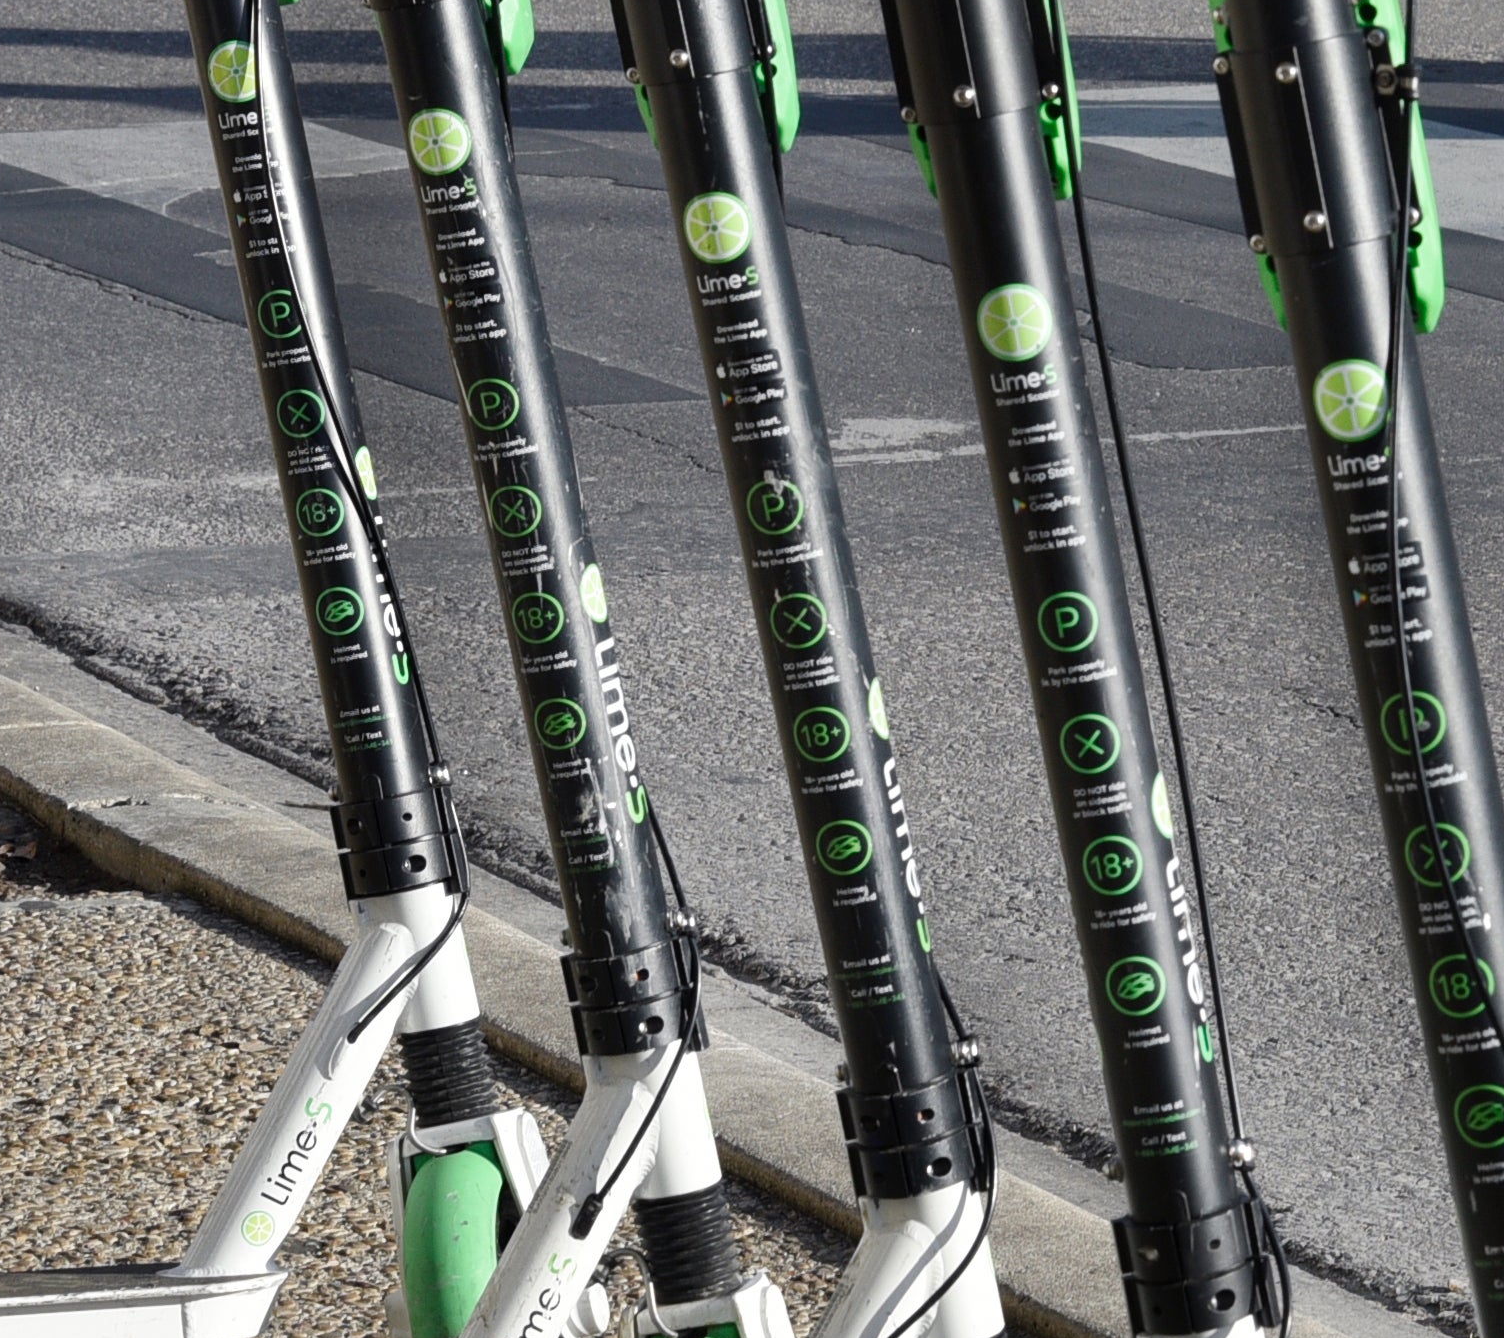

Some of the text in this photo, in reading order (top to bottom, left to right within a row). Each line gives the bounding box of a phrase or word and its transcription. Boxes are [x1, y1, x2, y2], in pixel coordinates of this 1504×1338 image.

[244, 190, 262, 203] App
[447, 236, 485, 250] Lime App
[450, 266, 495, 284] App Store
[456, 296, 483, 309] Google
[484, 292, 501, 303] Play
[729, 289, 762, 302] Scooter
[270, 301, 290, 328] P
[478, 328, 507, 340] in app
[716, 318, 759, 334] Download
[727, 332, 748, 343] Lime
[749, 328, 768, 340] App
[729, 360, 779, 379] App Store
[735, 392, 767, 405] Google
[766, 388, 785, 399] Play
[996, 388, 1060, 407] Shared Scooter
[480, 391, 501, 419] P
[745, 421, 755, 430] to
[1012, 421, 1056, 436] Download
[731, 425, 791, 443] unlock in app
[1023, 434, 1046, 445] Lime
[1047, 431, 1065, 442] App
[1024, 465, 1074, 483] App Store
[762, 493, 785, 522] P
[1029, 498, 1063, 511] Google
[1063, 495, 1081, 506] Play
[302, 503, 336, 526] 18+
[1028, 529, 1050, 540] $1 to
[1362, 522, 1387, 534] Lime
[757, 542, 812, 558] Park properly
[1023, 535, 1086, 553] unlock in app
[1364, 561, 1388, 574] App
[518, 607, 555, 631] 18+
[1055, 606, 1079, 638] P
[783, 656, 834, 671] DO NOT ride
[1048, 660, 1105, 676] Park properly
[797, 665, 835, 680] sidewalk
[791, 674, 841, 691] block traffic
[1051, 677, 1061, 688] by
[1062, 676, 1077, 686] the
[800, 722, 842, 748] 18+
[840, 768, 855, 780] old
[825, 783, 837, 792] for
[839, 776, 864, 791] safety
[1073, 788, 1086, 797] DO
[1088, 784, 1107, 795] NOT
[1088, 791, 1127, 806] sidewalk
[1082, 801, 1133, 819] block traffic
[1091, 852, 1134, 880] 18+
[1133, 901, 1148, 913] old
[1418, 902, 1432, 913] DO
[1117, 917, 1131, 926] for
[1131, 912, 1157, 926] safety
[1427, 923, 1454, 936] block
[843, 953, 891, 970] Email us at
[851, 984, 895, 999] Call Text
[1132, 1032, 1171, 1049] required
[1133, 1099, 1184, 1116] Email us at
[1141, 1131, 1187, 1147] Call Text
